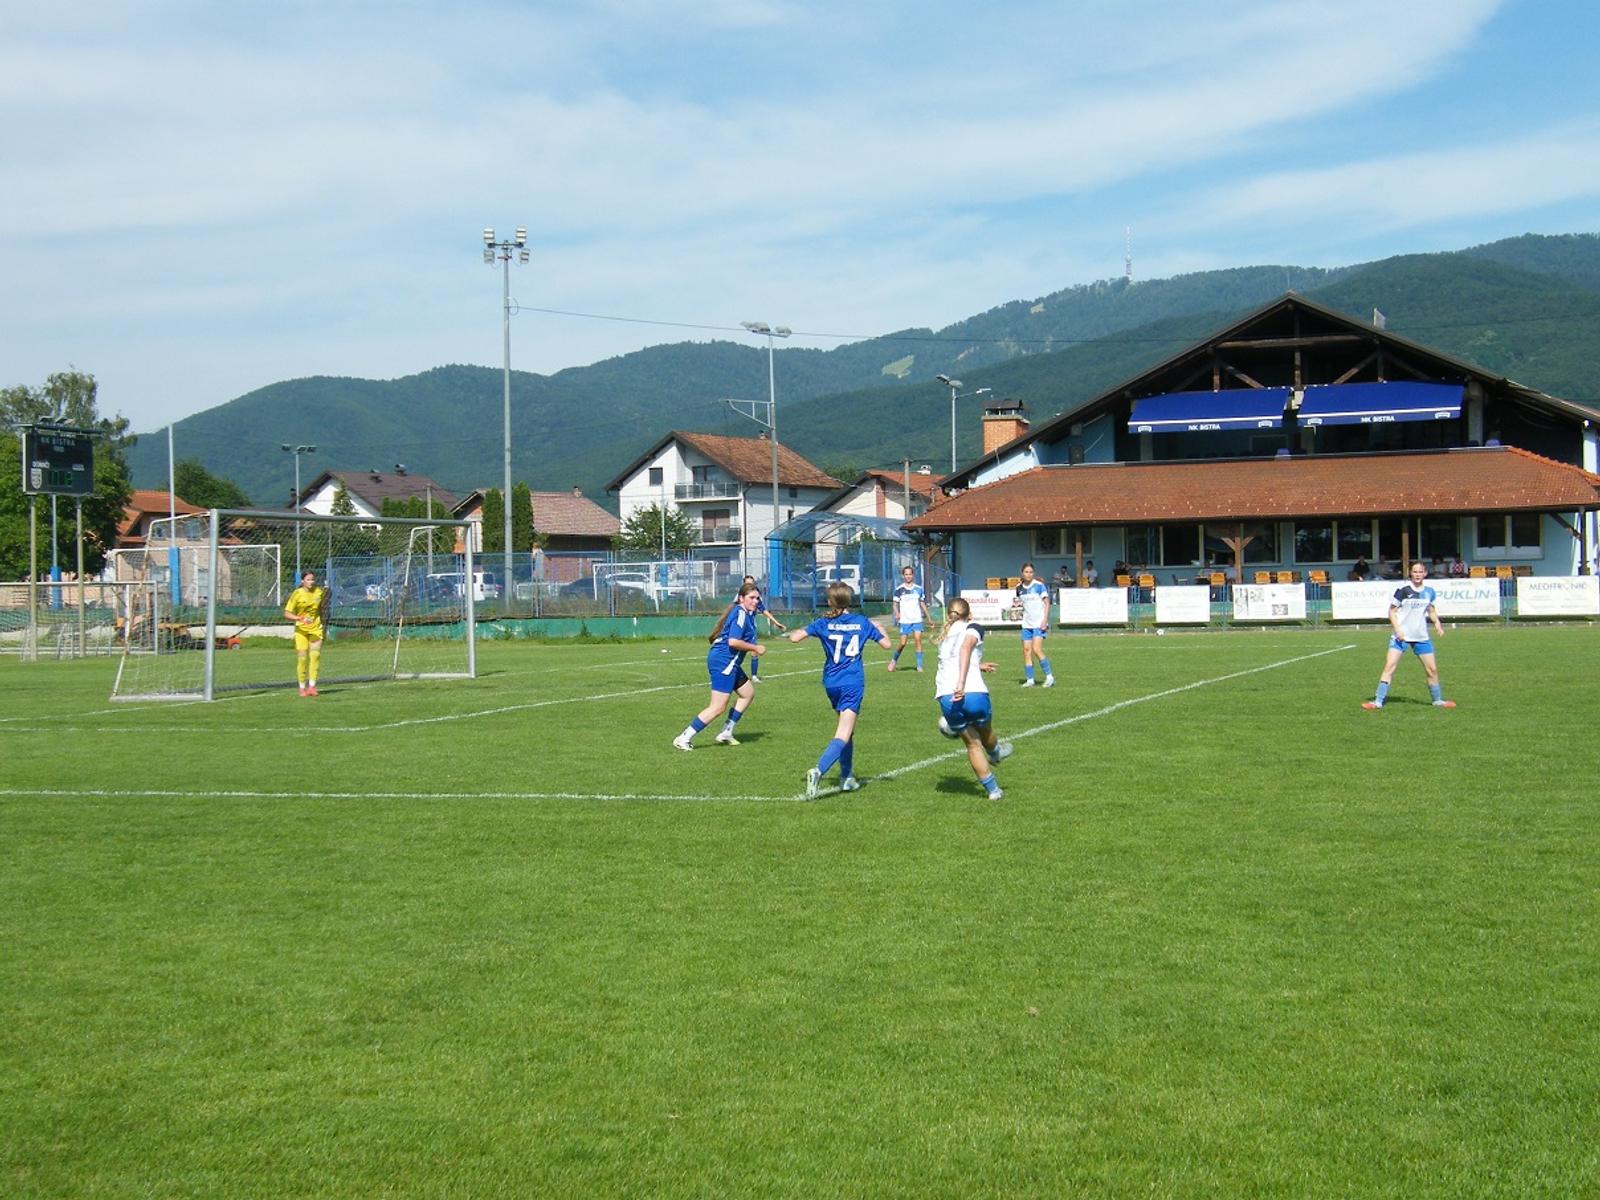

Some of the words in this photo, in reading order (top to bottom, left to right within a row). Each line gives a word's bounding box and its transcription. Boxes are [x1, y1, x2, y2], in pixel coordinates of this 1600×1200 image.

[1360, 415, 1371, 423] NK
[1372, 414, 1395, 422] BISTRA
[1188, 423, 1199, 431] NK
[1200, 423, 1221, 431] BISTRA
[1435, 589, 1490, 600] PUKLIN
[828, 634, 860, 664] 74
